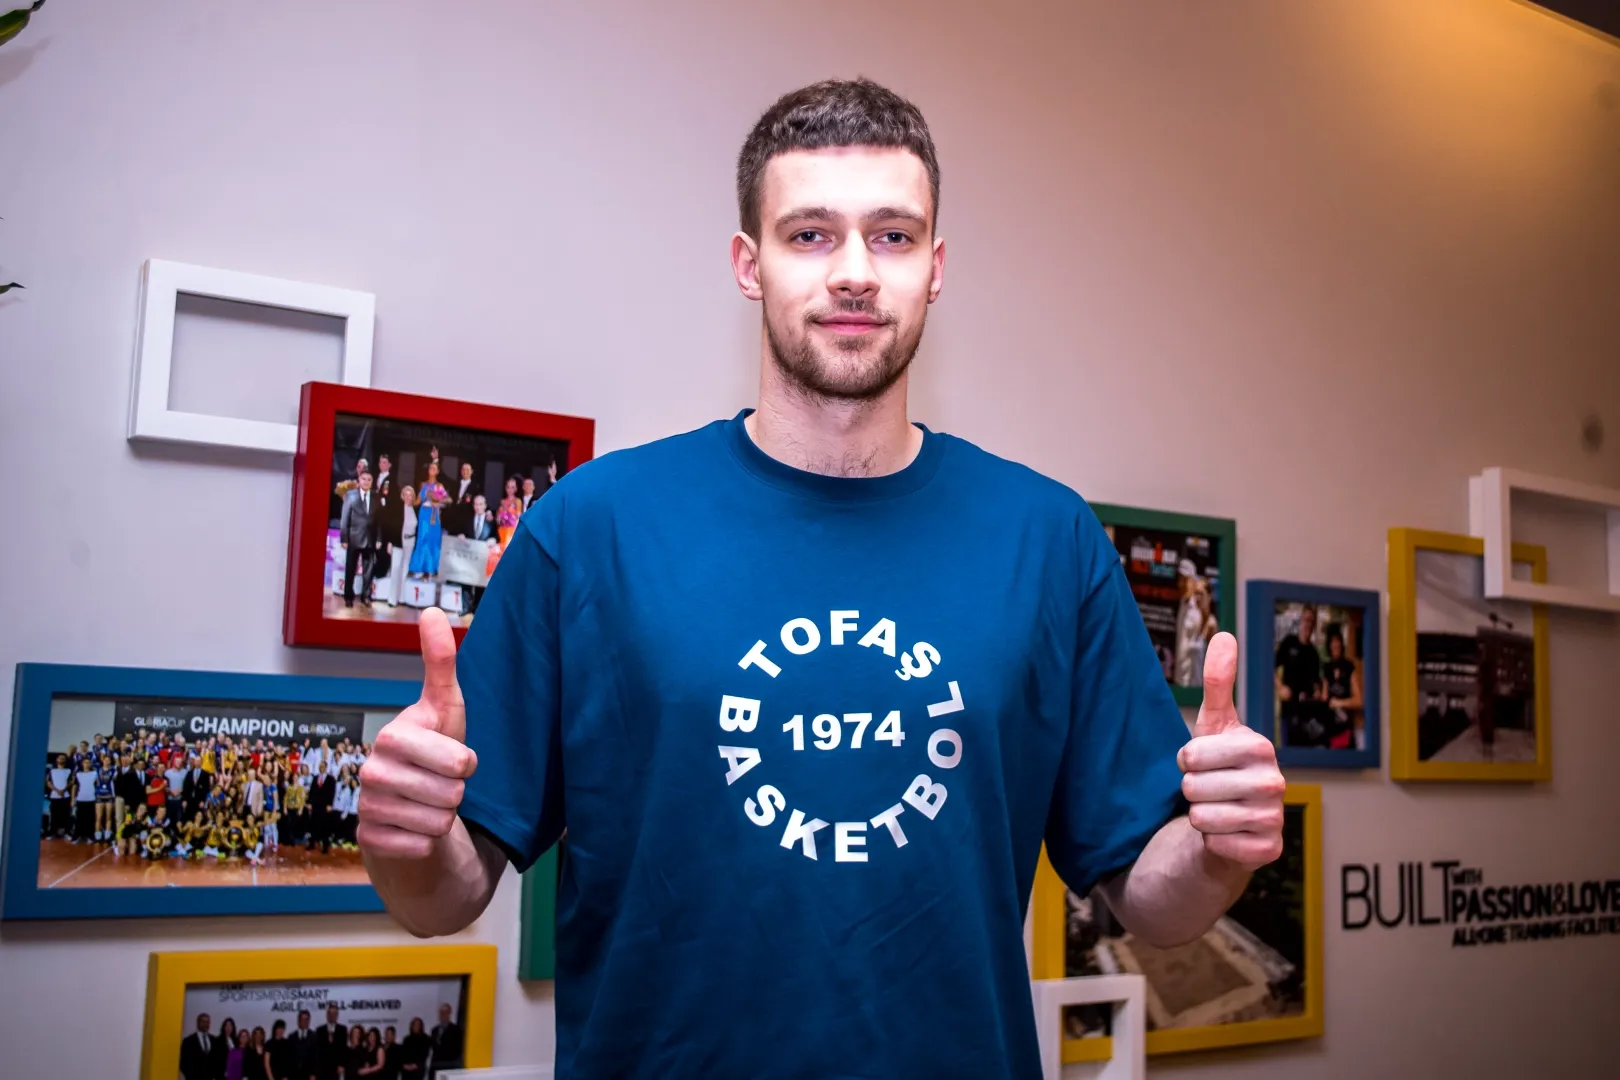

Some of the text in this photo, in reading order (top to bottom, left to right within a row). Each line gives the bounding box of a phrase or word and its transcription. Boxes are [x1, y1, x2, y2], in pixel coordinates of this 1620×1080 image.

[738, 610, 941, 681] TOFAŞ
[190, 716, 294, 738] CHAMPION
[783, 710, 905, 751] 1974
[717, 680, 965, 863] BASKETBOL
[1341, 860, 1460, 931] BUILT
